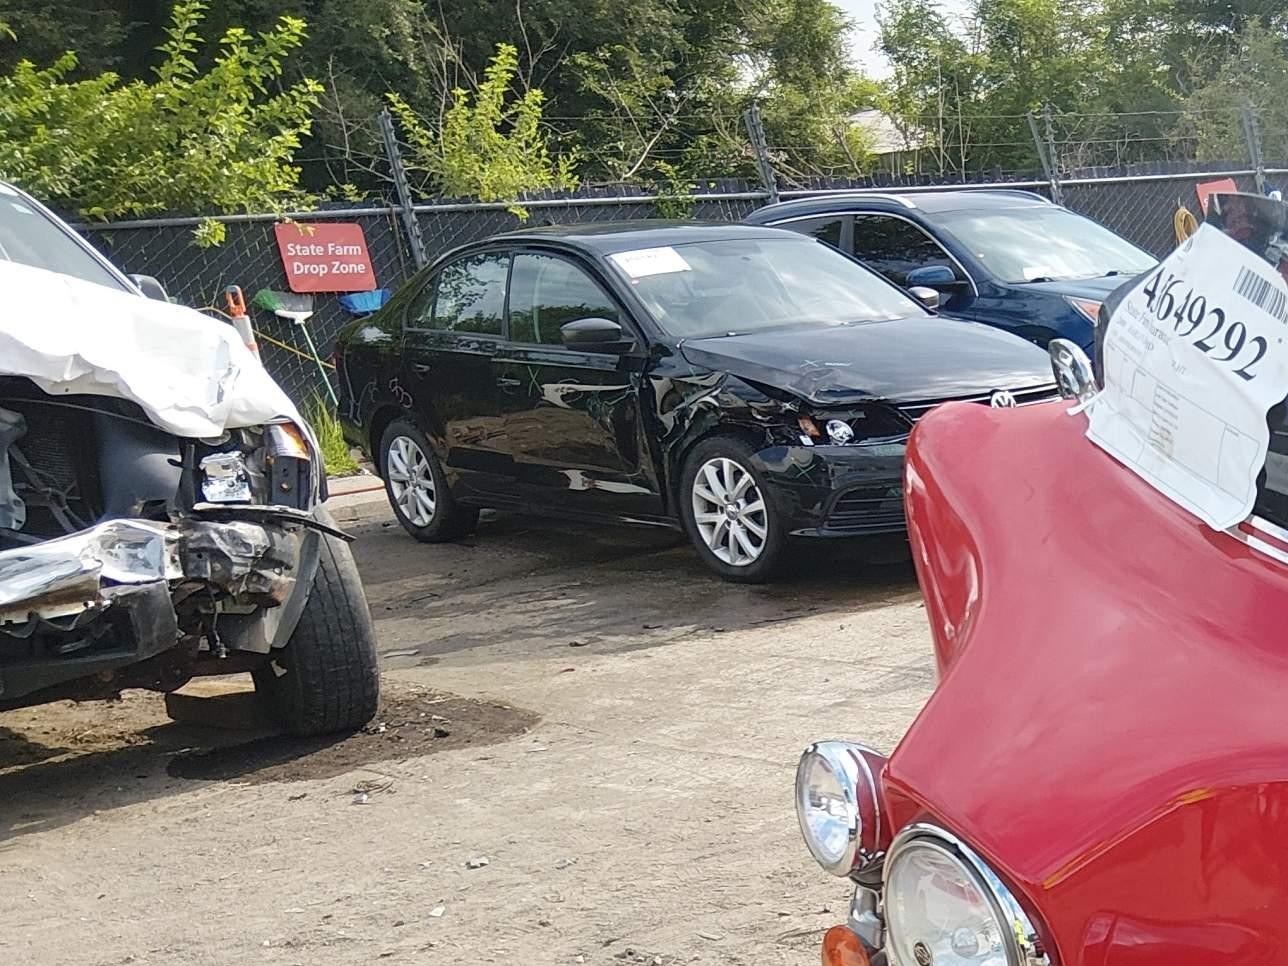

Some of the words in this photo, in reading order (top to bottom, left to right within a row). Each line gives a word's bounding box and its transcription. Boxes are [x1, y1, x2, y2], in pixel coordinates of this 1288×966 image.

[287, 243, 324, 256] State
[327, 243, 361, 255] Farm
[293, 262, 328, 276] Drop
[331, 261, 366, 273] Zone
